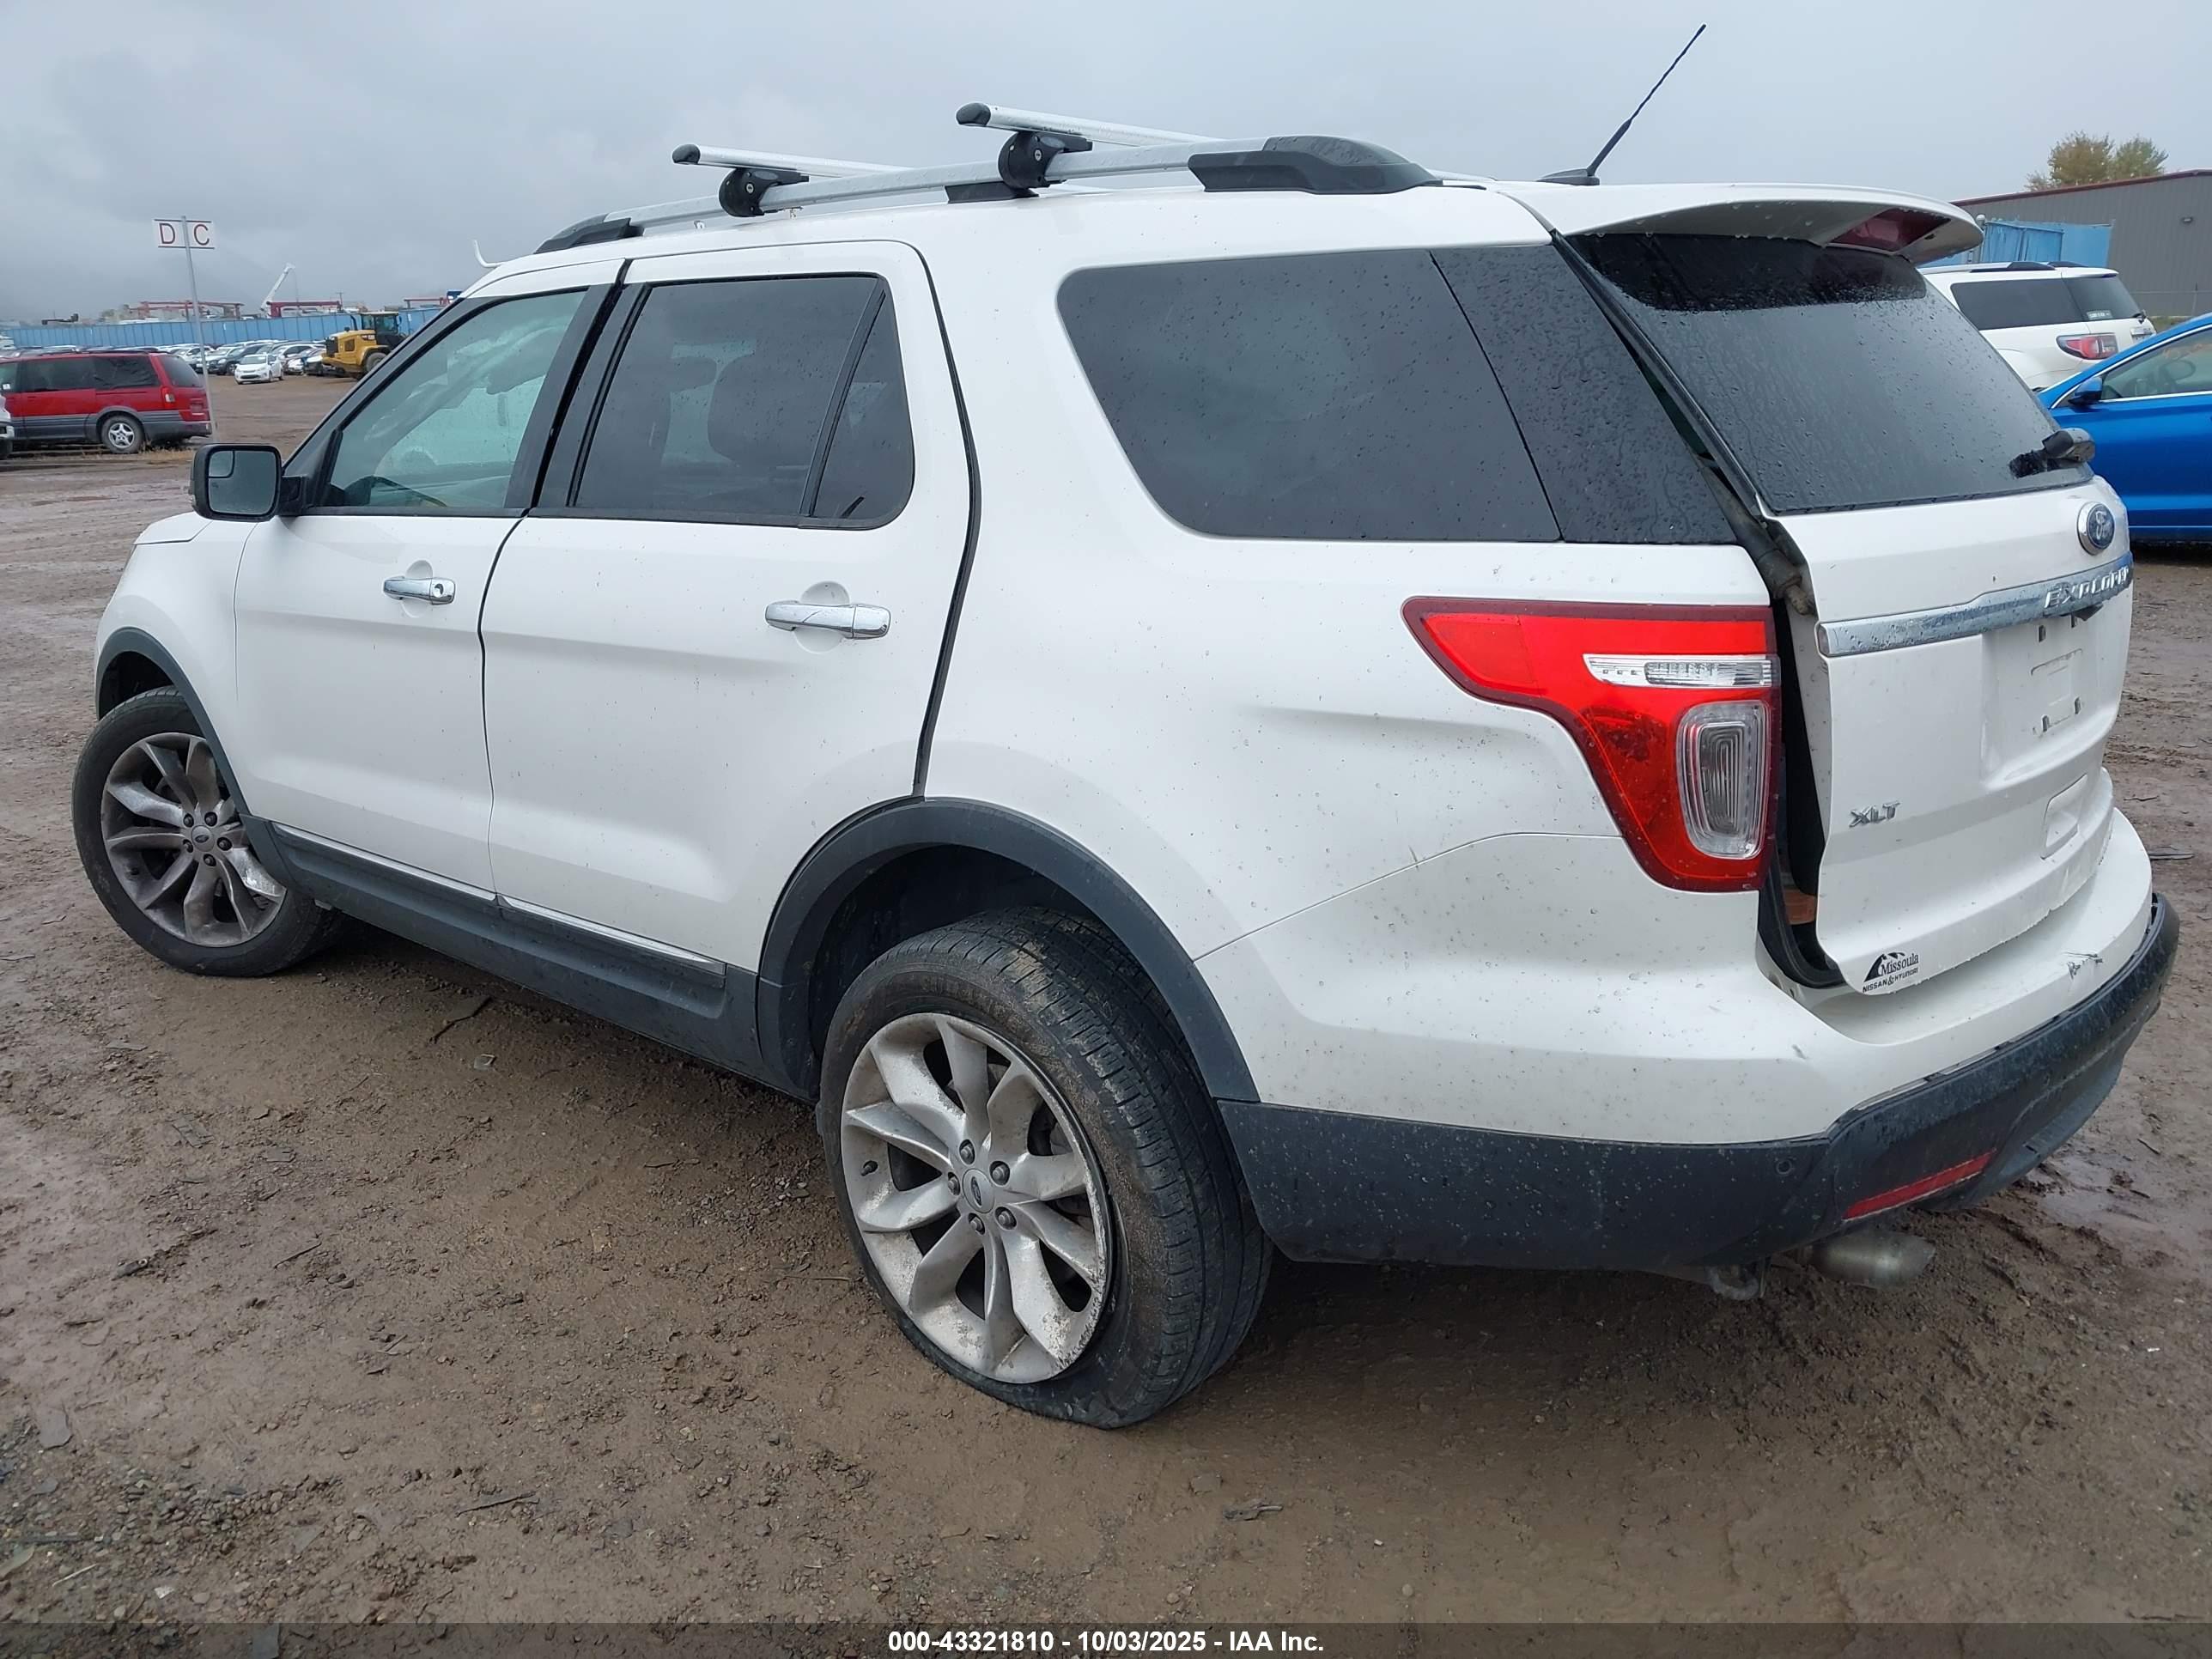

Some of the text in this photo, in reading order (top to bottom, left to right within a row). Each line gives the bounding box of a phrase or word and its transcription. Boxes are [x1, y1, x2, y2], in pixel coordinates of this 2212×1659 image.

[159, 222, 210, 246] D C
[1849, 801, 1901, 828] XLT
[1881, 953, 1919, 976] Missoula
[1863, 978, 1888, 993] NISSAN
